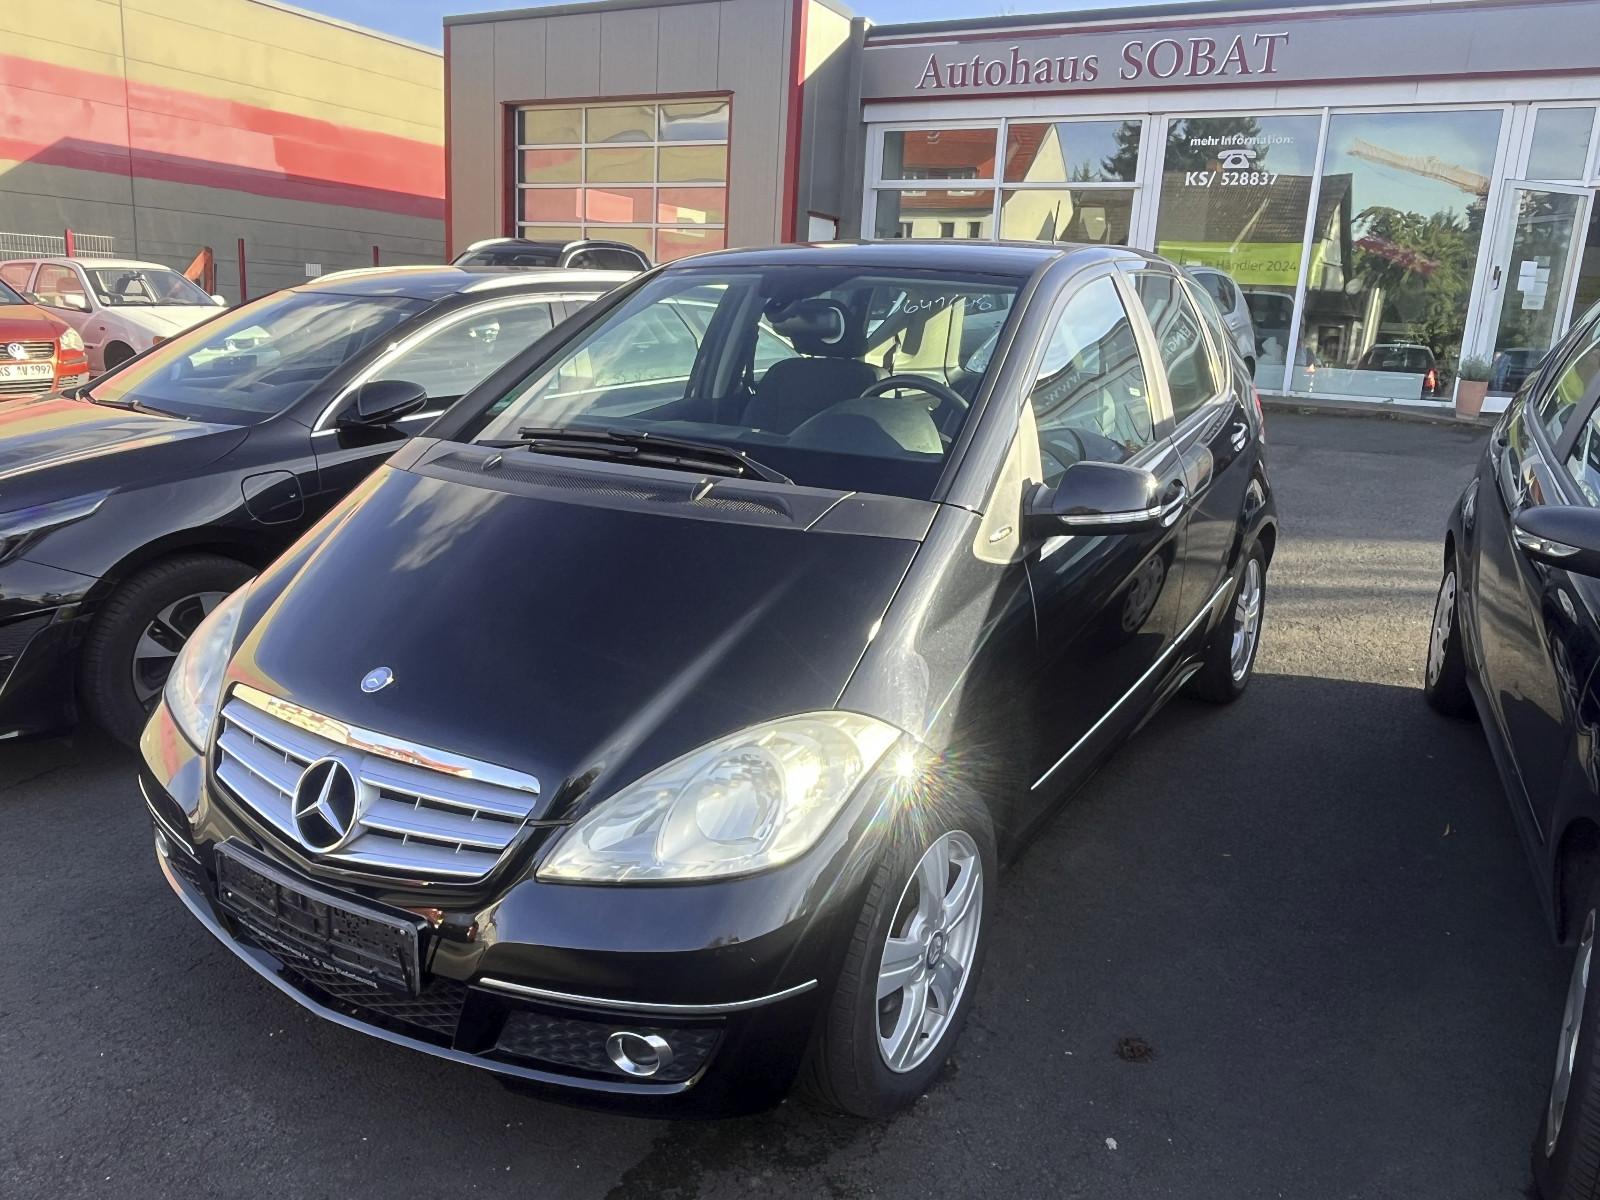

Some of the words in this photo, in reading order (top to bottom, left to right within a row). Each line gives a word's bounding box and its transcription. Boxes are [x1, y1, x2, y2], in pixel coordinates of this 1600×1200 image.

[915, 46, 1099, 89] Autohaus
[1119, 32, 1289, 80] SOBAT
[1190, 135, 1219, 146] mehr
[1220, 134, 1294, 146] Information:
[1185, 171, 1216, 188] KS/
[1220, 171, 1279, 186] 528837
[1266, 261, 1296, 272] 2024
